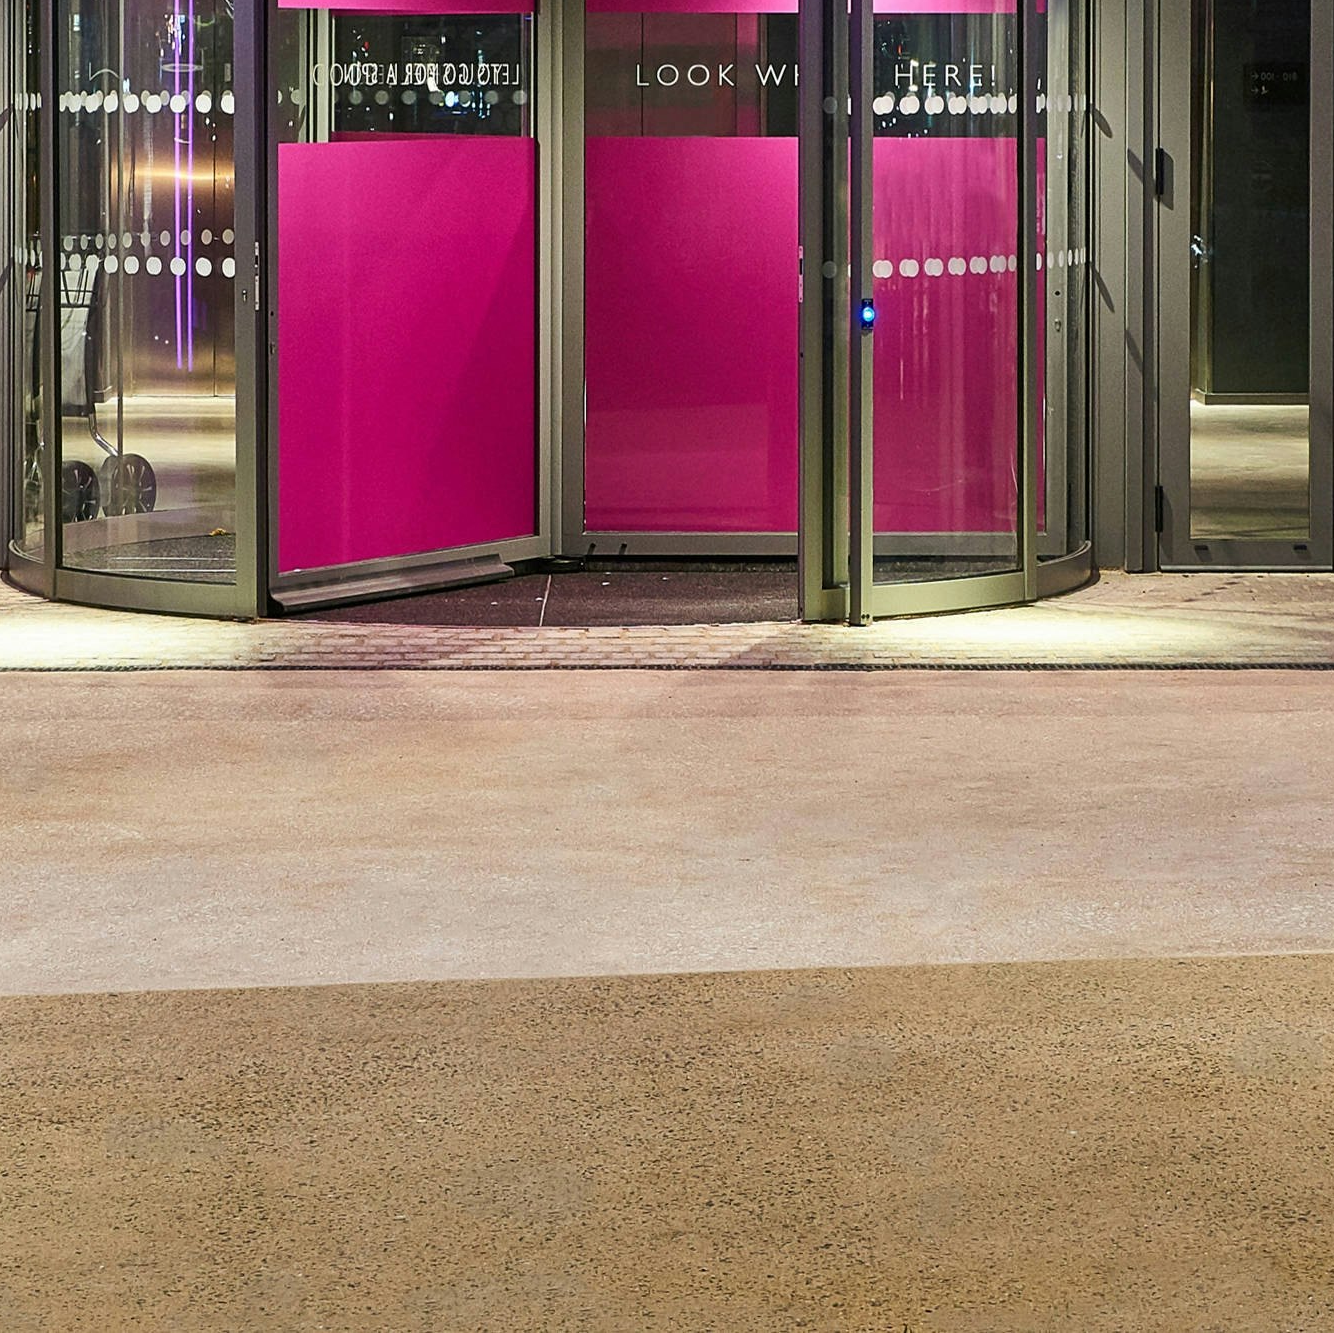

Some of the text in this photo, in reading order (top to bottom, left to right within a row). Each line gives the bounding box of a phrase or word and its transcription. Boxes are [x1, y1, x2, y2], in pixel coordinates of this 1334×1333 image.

[636, 63, 996, 87] LOOK W HERE!
